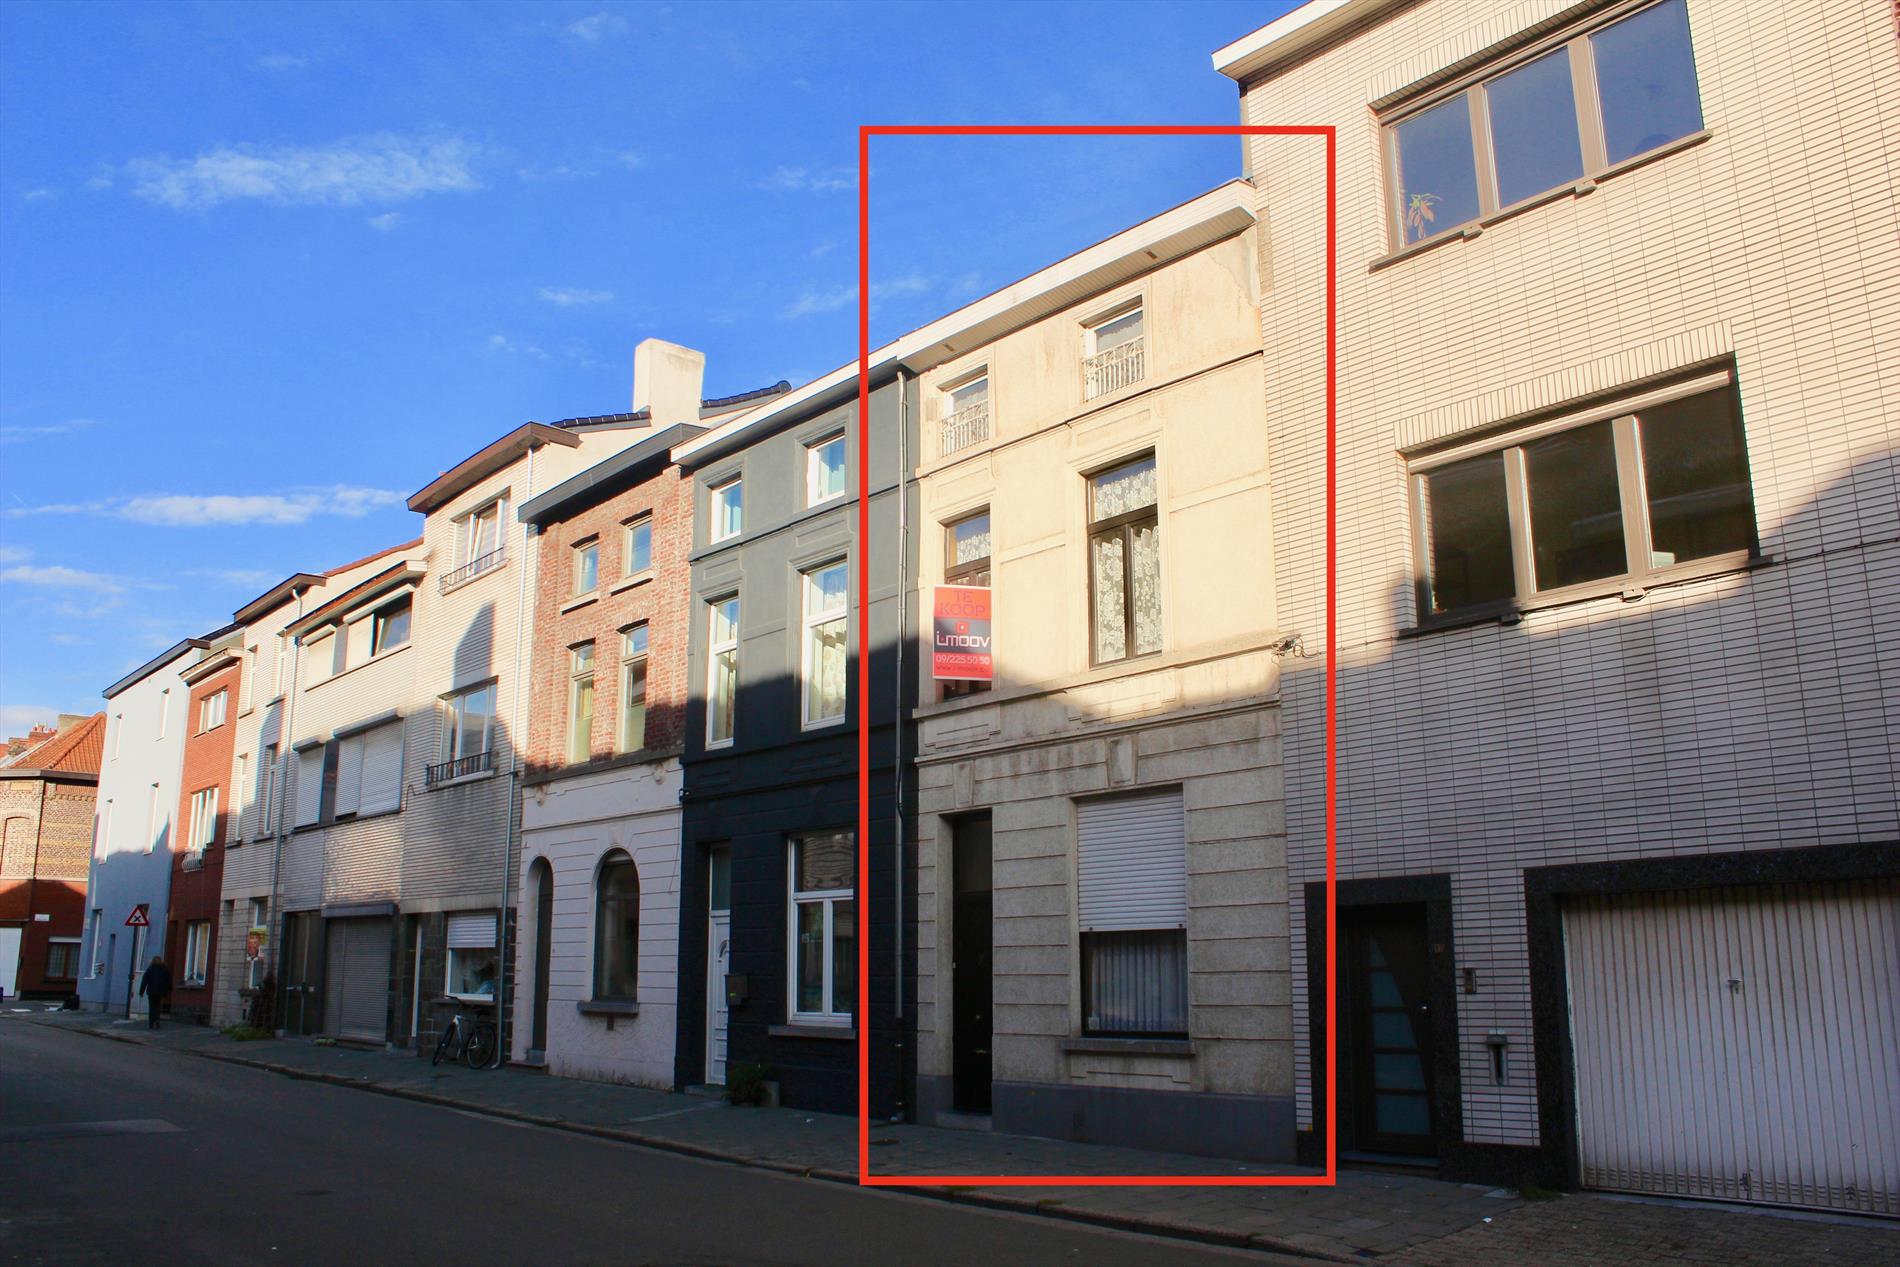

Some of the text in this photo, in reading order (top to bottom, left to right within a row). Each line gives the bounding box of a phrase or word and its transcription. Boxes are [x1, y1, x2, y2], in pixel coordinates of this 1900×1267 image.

[953, 590, 973, 603] TE
[940, 602, 985, 616] KOOP
[979, 656, 991, 665] 50
